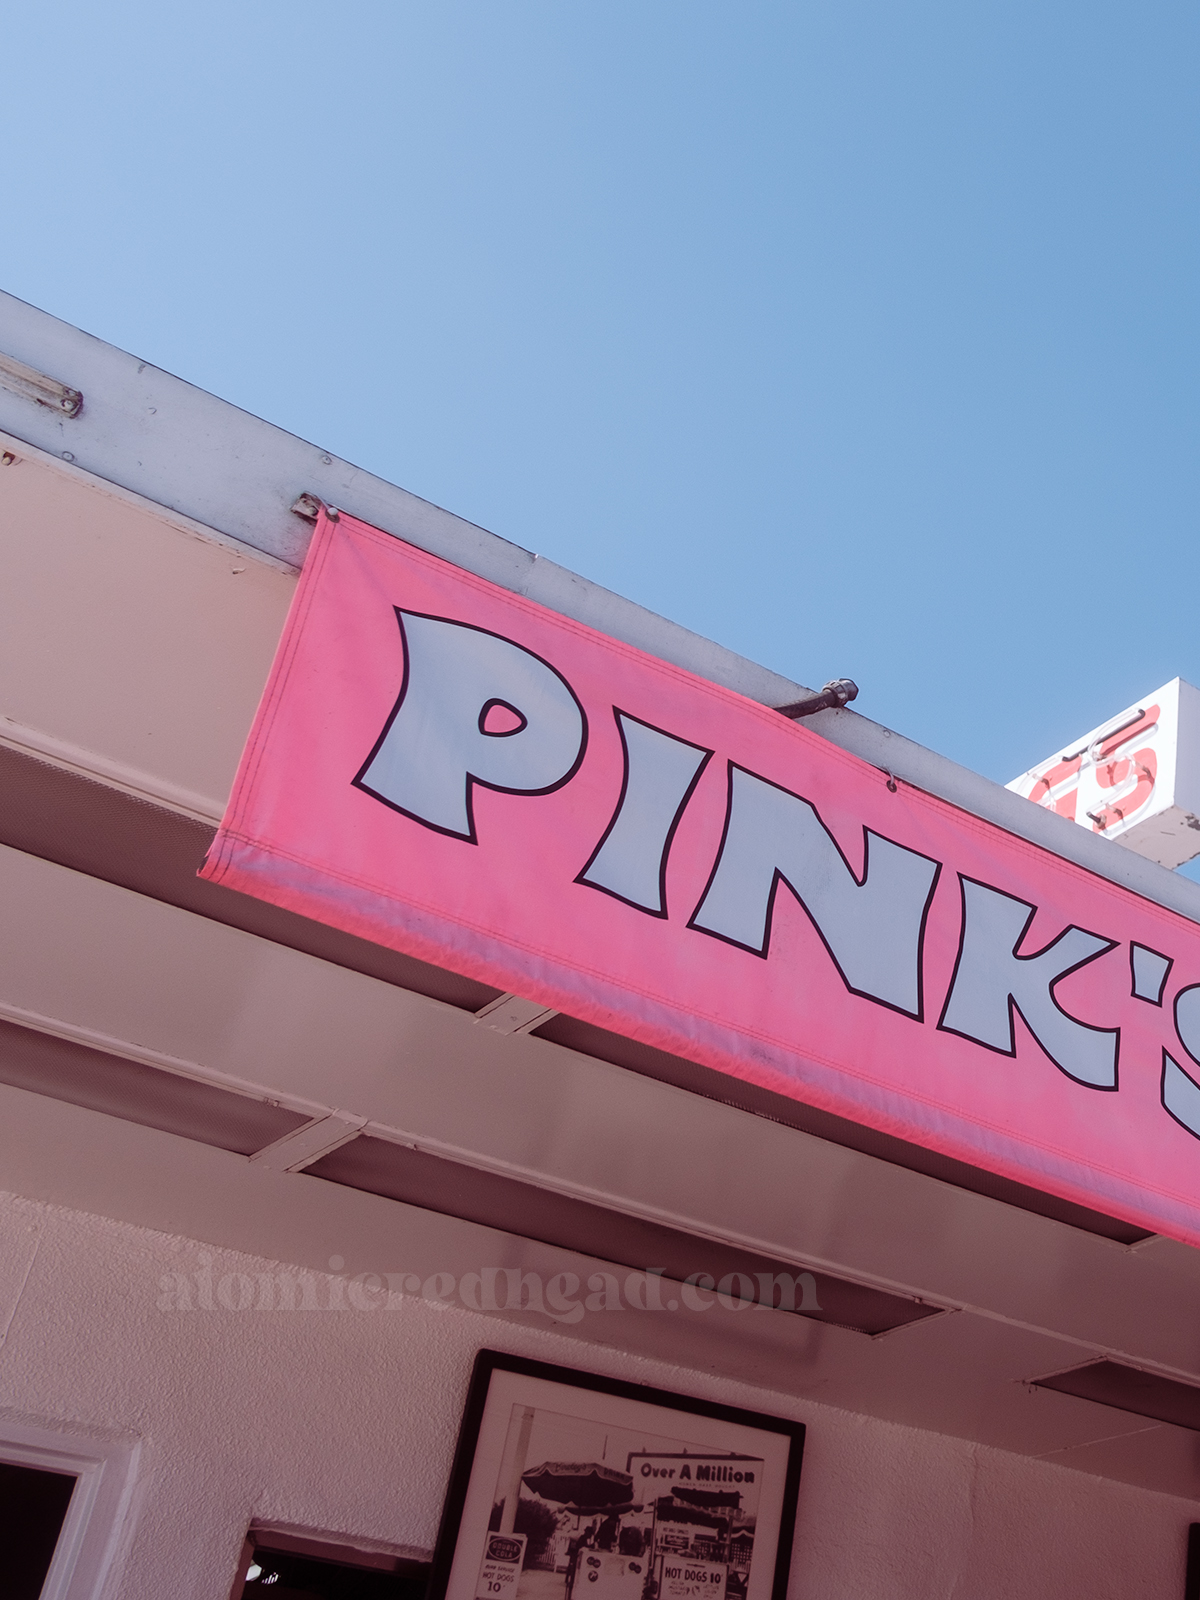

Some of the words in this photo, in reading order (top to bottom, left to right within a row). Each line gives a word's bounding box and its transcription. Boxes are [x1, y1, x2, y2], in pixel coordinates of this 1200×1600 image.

[640, 1462, 676, 1479] Over
[679, 1464, 691, 1480] A
[696, 1464, 755, 1483] Million
[665, 1567, 682, 1579] HOT
[685, 1569, 707, 1583] DOGS
